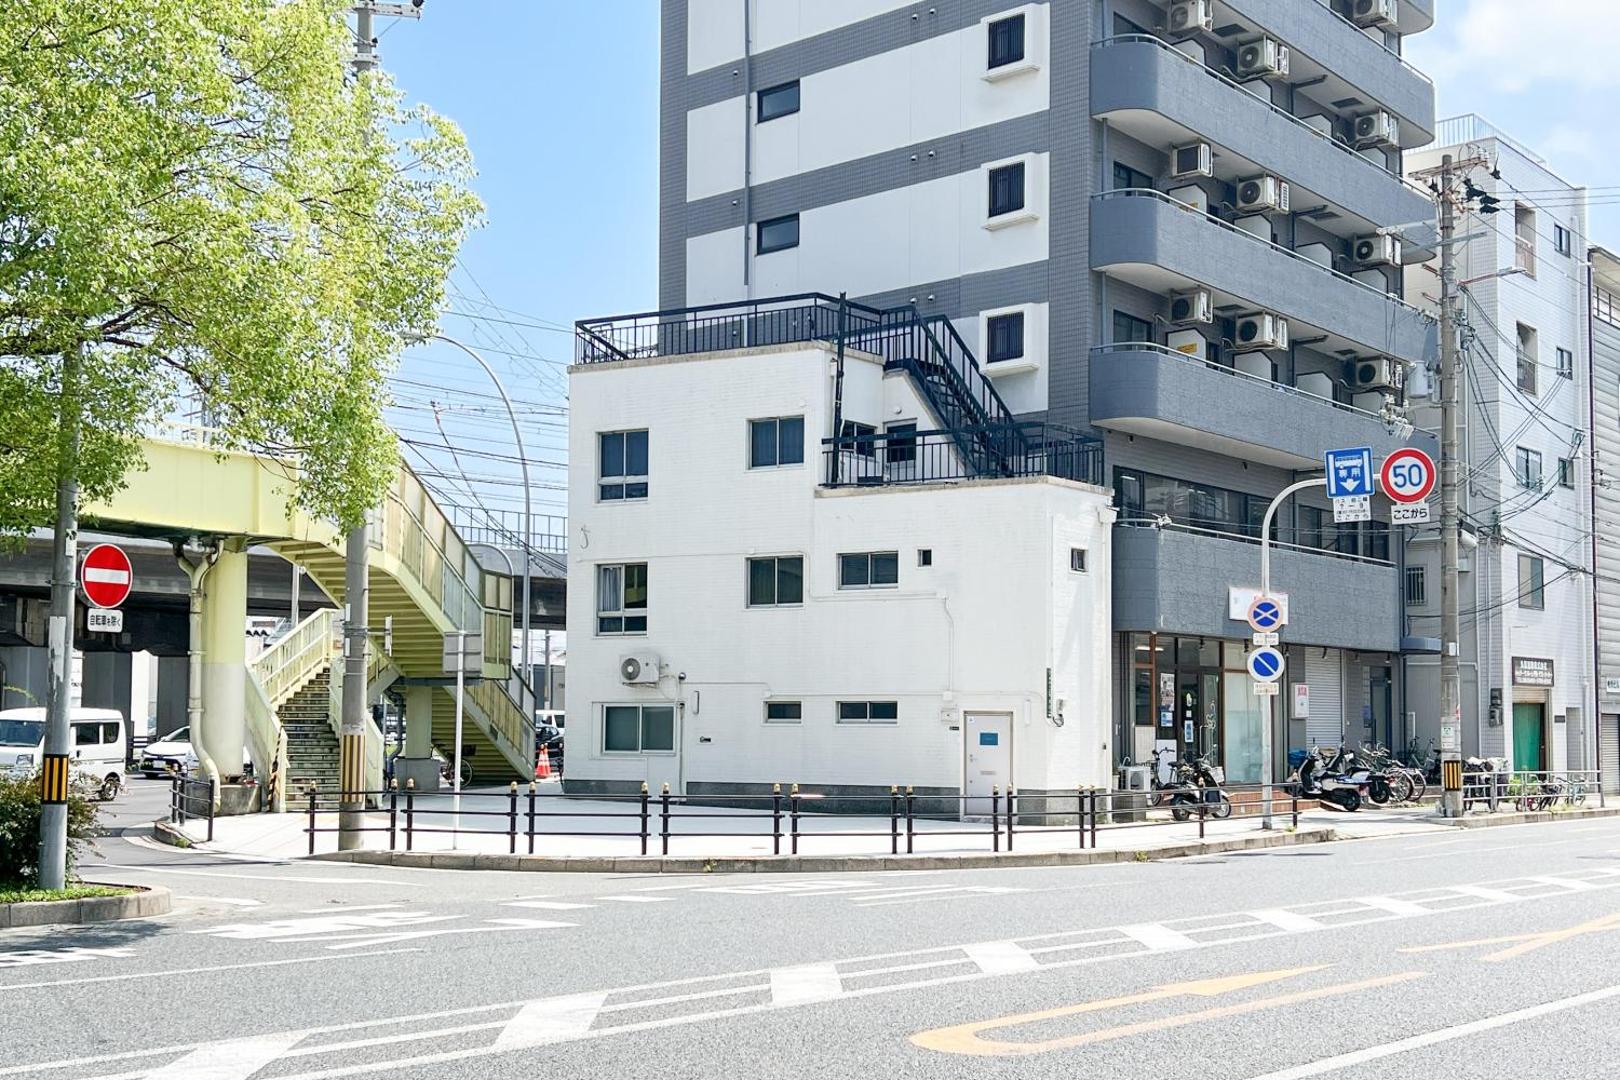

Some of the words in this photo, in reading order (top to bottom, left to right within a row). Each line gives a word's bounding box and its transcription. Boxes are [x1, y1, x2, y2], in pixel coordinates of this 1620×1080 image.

[1393, 463, 1422, 488] 50
[1393, 508, 1428, 520] ここから
